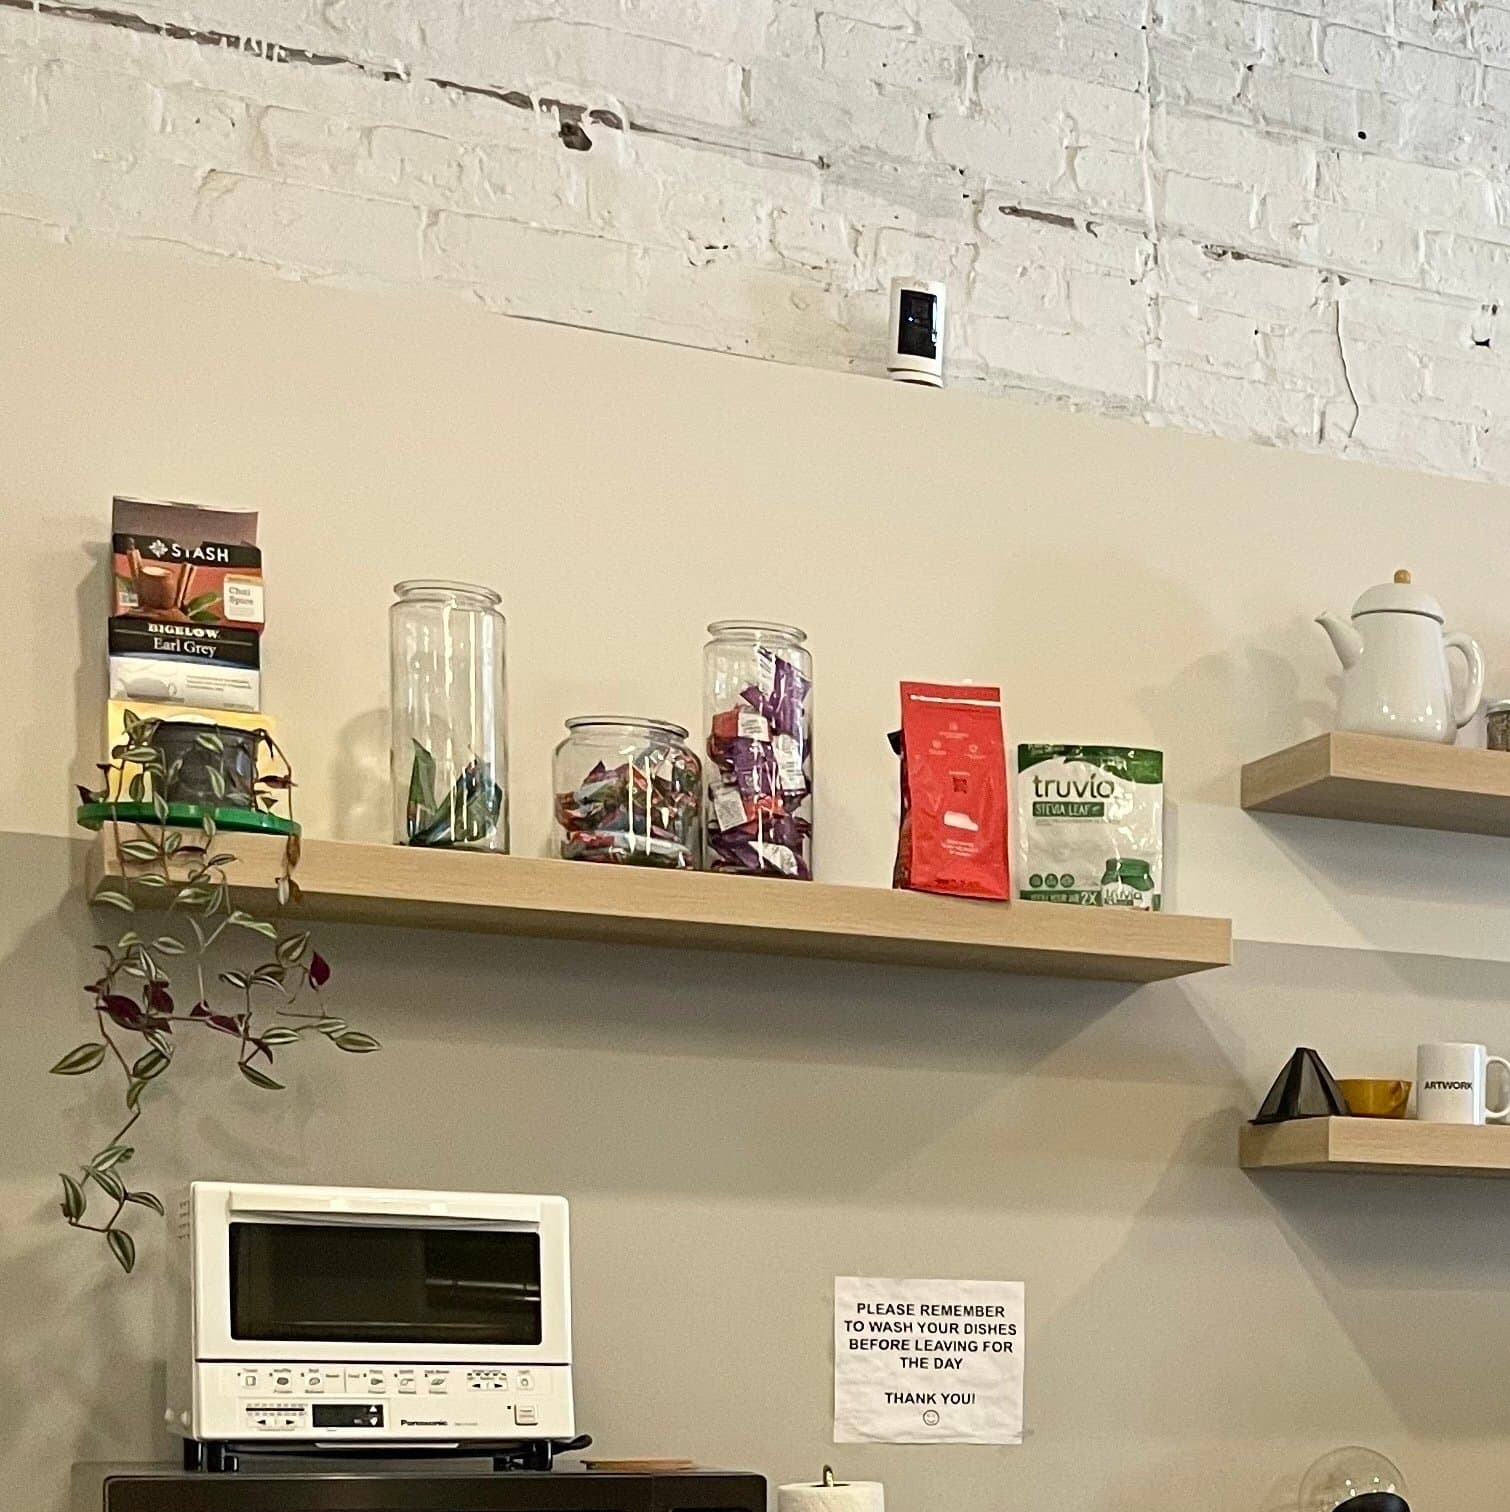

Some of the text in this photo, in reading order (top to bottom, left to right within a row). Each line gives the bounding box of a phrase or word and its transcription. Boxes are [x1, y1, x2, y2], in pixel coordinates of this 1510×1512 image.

[148, 623, 220, 639] BIGELOW
[153, 637, 217, 658] Earl Grey
[1035, 803, 1090, 816] STEVIA LEAF
[1424, 1081, 1472, 1090] ARTWORK
[857, 1303, 1005, 1318] PLEASE REMEMBER
[844, 1320, 1017, 1336] TO WASH YOUR DISHES
[849, 1339, 1014, 1353] BEFORE LEAVING FOR
[900, 1357, 963, 1370] THE DAY
[884, 1392, 976, 1405] THANK YOU!
